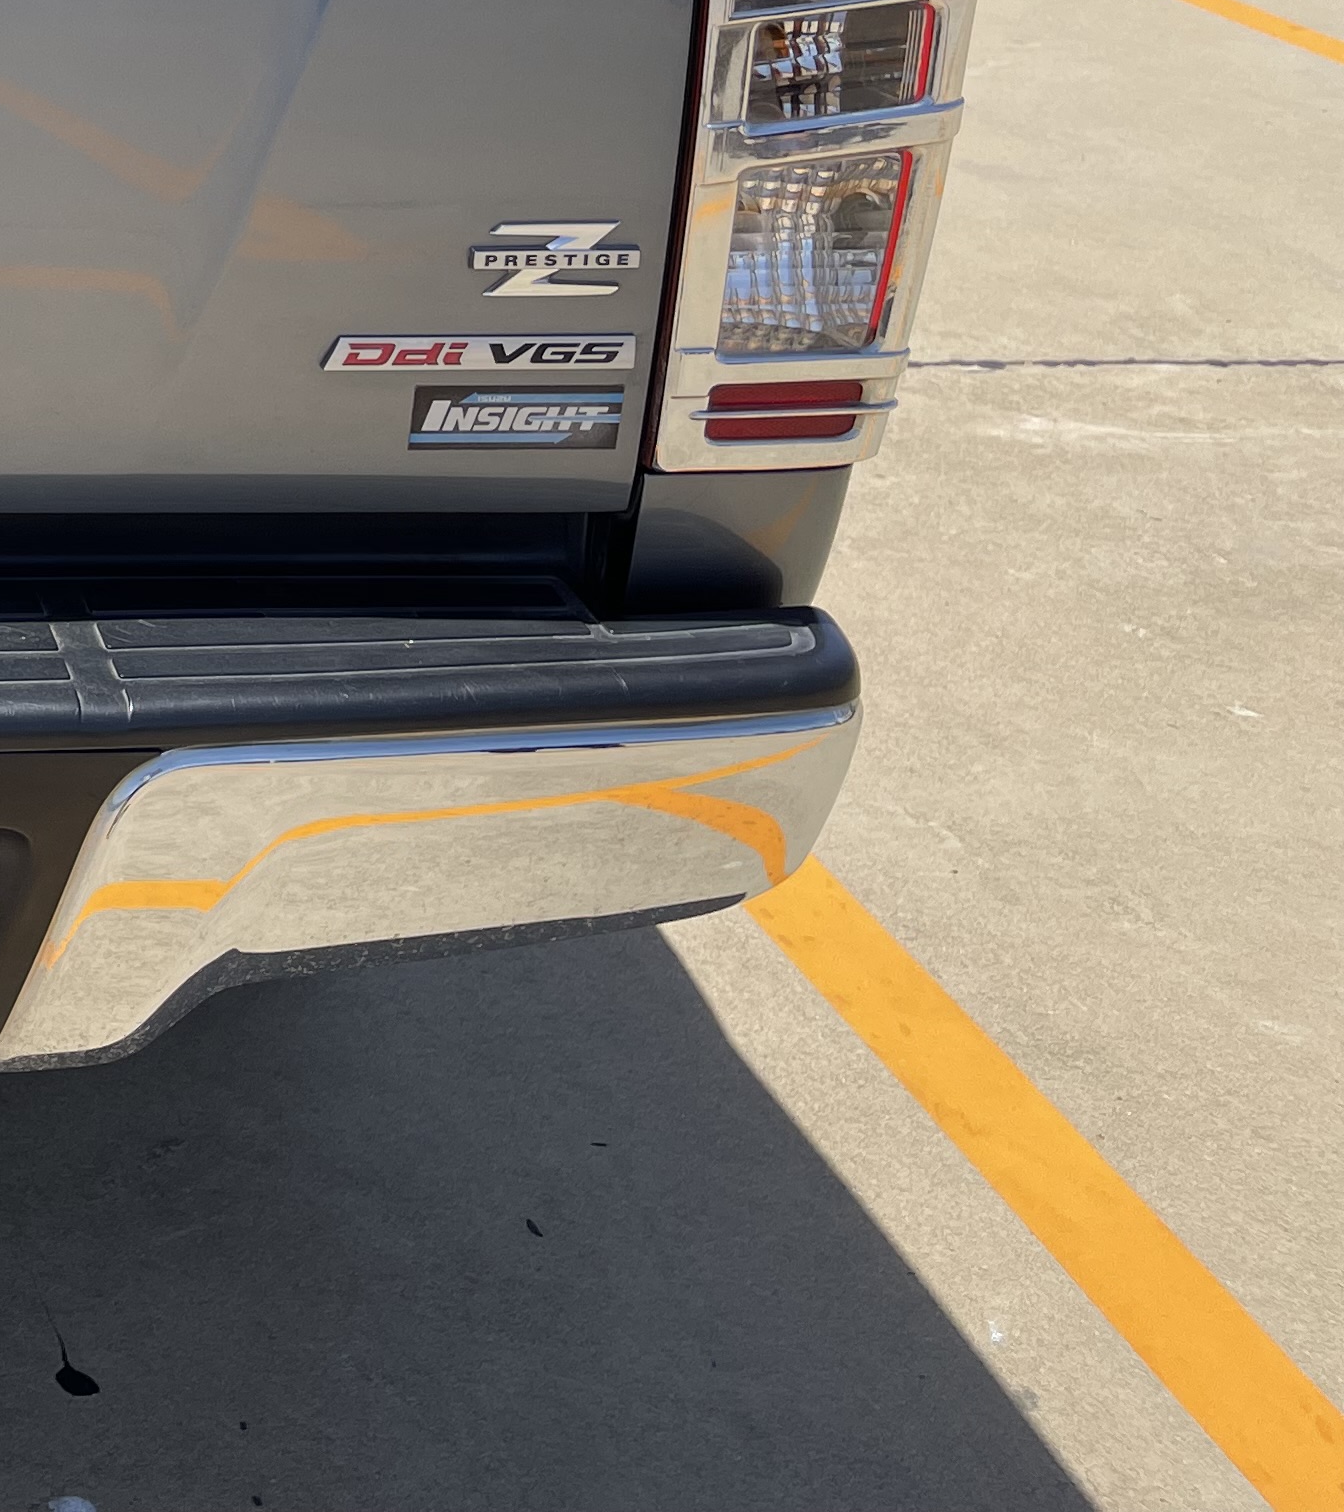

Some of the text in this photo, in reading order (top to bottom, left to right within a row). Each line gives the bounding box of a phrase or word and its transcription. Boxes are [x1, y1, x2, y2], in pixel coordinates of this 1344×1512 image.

[484, 253, 631, 267] PRESTIGE
[341, 341, 624, 366] Ddi VGS
[420, 399, 609, 432] INSIGHT
